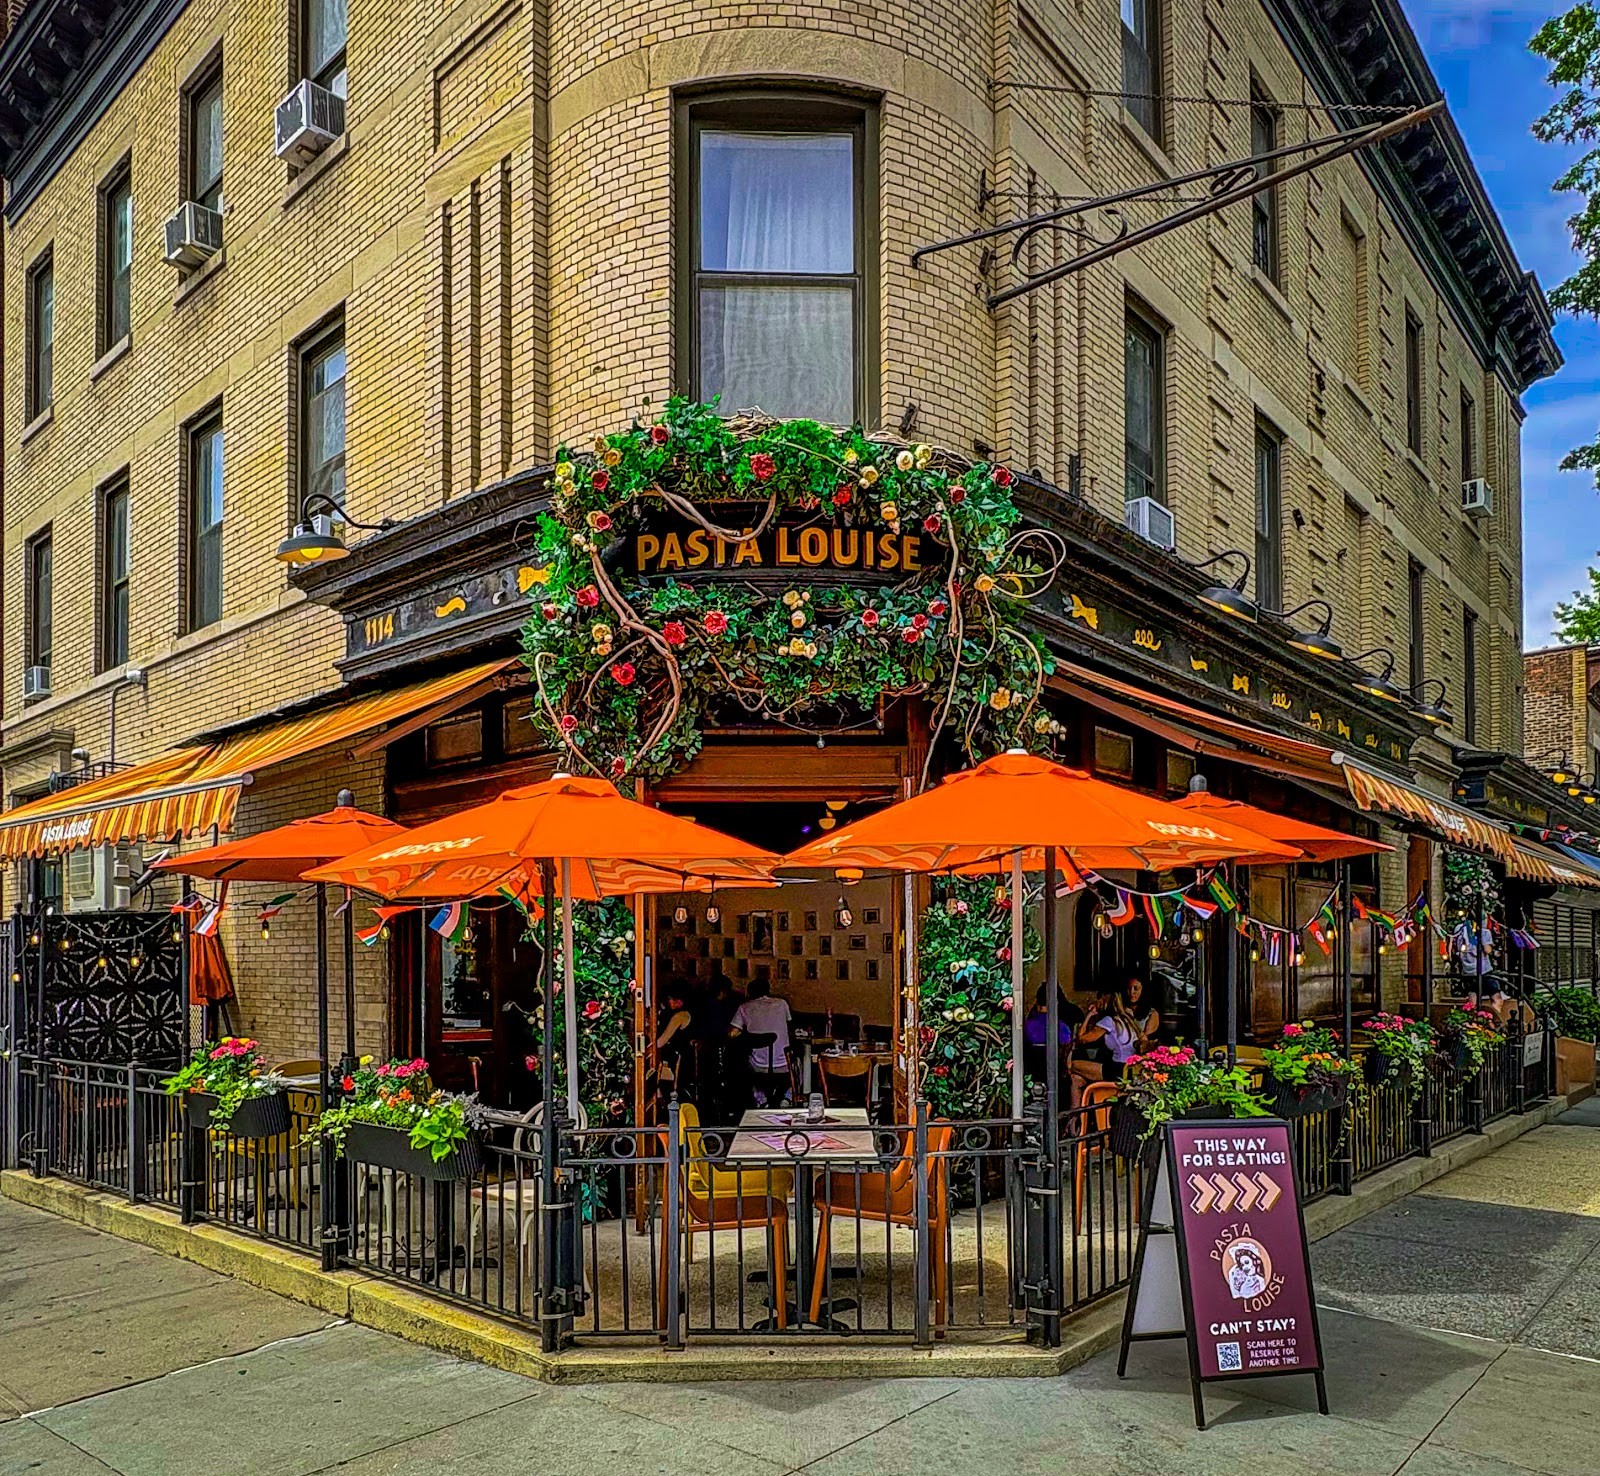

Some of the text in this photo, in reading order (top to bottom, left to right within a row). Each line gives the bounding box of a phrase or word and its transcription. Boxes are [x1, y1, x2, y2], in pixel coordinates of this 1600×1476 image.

[637, 527, 922, 571] PASTA LOUISE
[365, 613, 393, 646] 1114
[1194, 1138, 1267, 1152] THIS WAY
[1183, 1152, 1286, 1167] FOR SEATING!
[1209, 1222, 1252, 1261] PASTA
[1243, 1272, 1285, 1313] LOUISE
[1210, 1318, 1296, 1335] CAN'T STAY?
[1246, 1338, 1297, 1350] SCAN HERE TO
[1250, 1347, 1295, 1358] RESERVE FOR
[1248, 1356, 1300, 1368] ANOTHER TIME!
